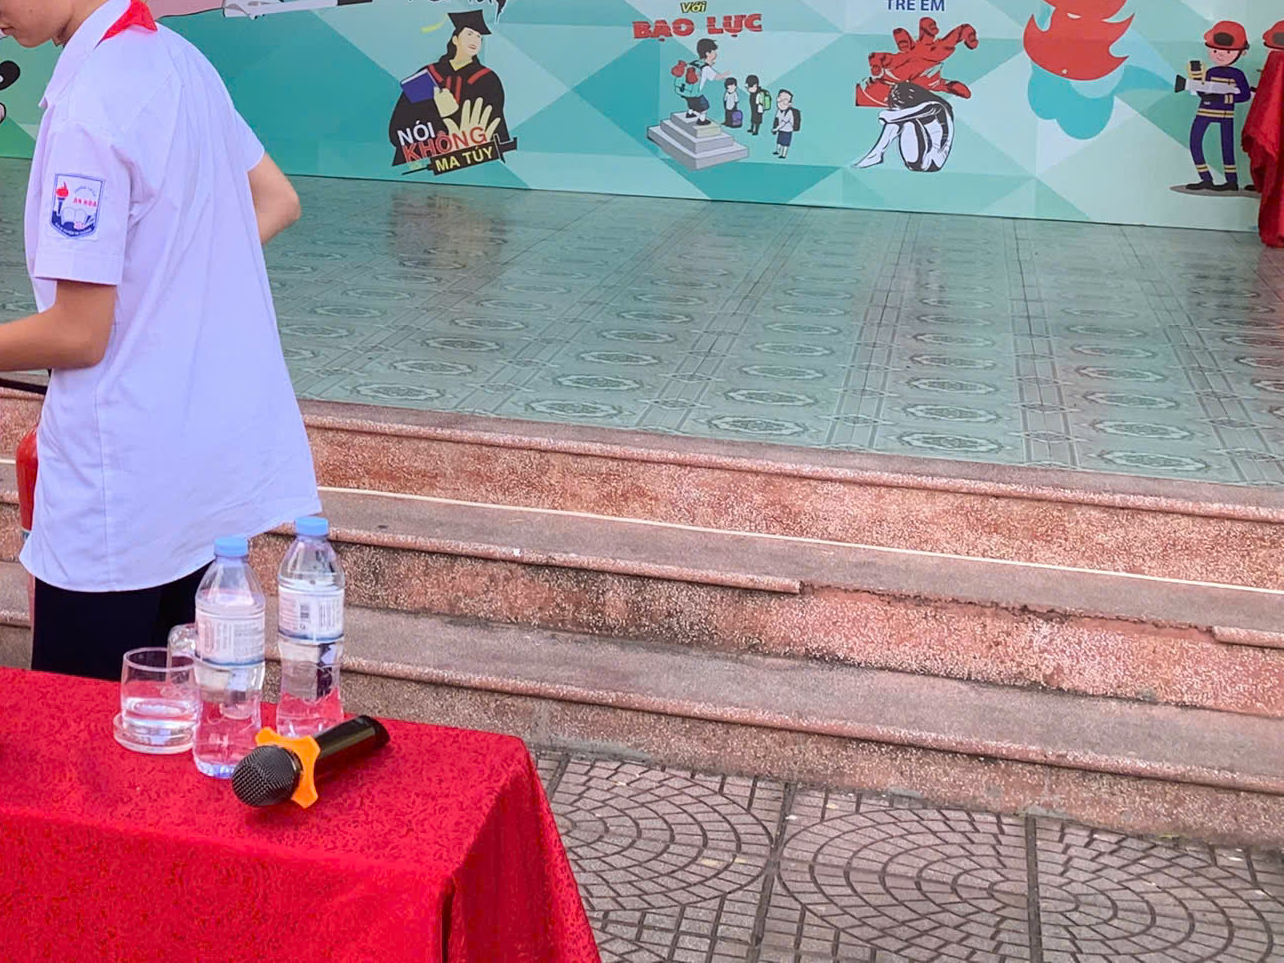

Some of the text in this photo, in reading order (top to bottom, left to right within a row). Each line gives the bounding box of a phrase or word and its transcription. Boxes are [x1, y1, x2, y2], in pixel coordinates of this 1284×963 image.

[632, 13, 763, 42] BẠO LỰC
[397, 120, 436, 146] NÓI
[402, 126, 488, 163] KHÔNG
[435, 146, 493, 172] MA TÚY
